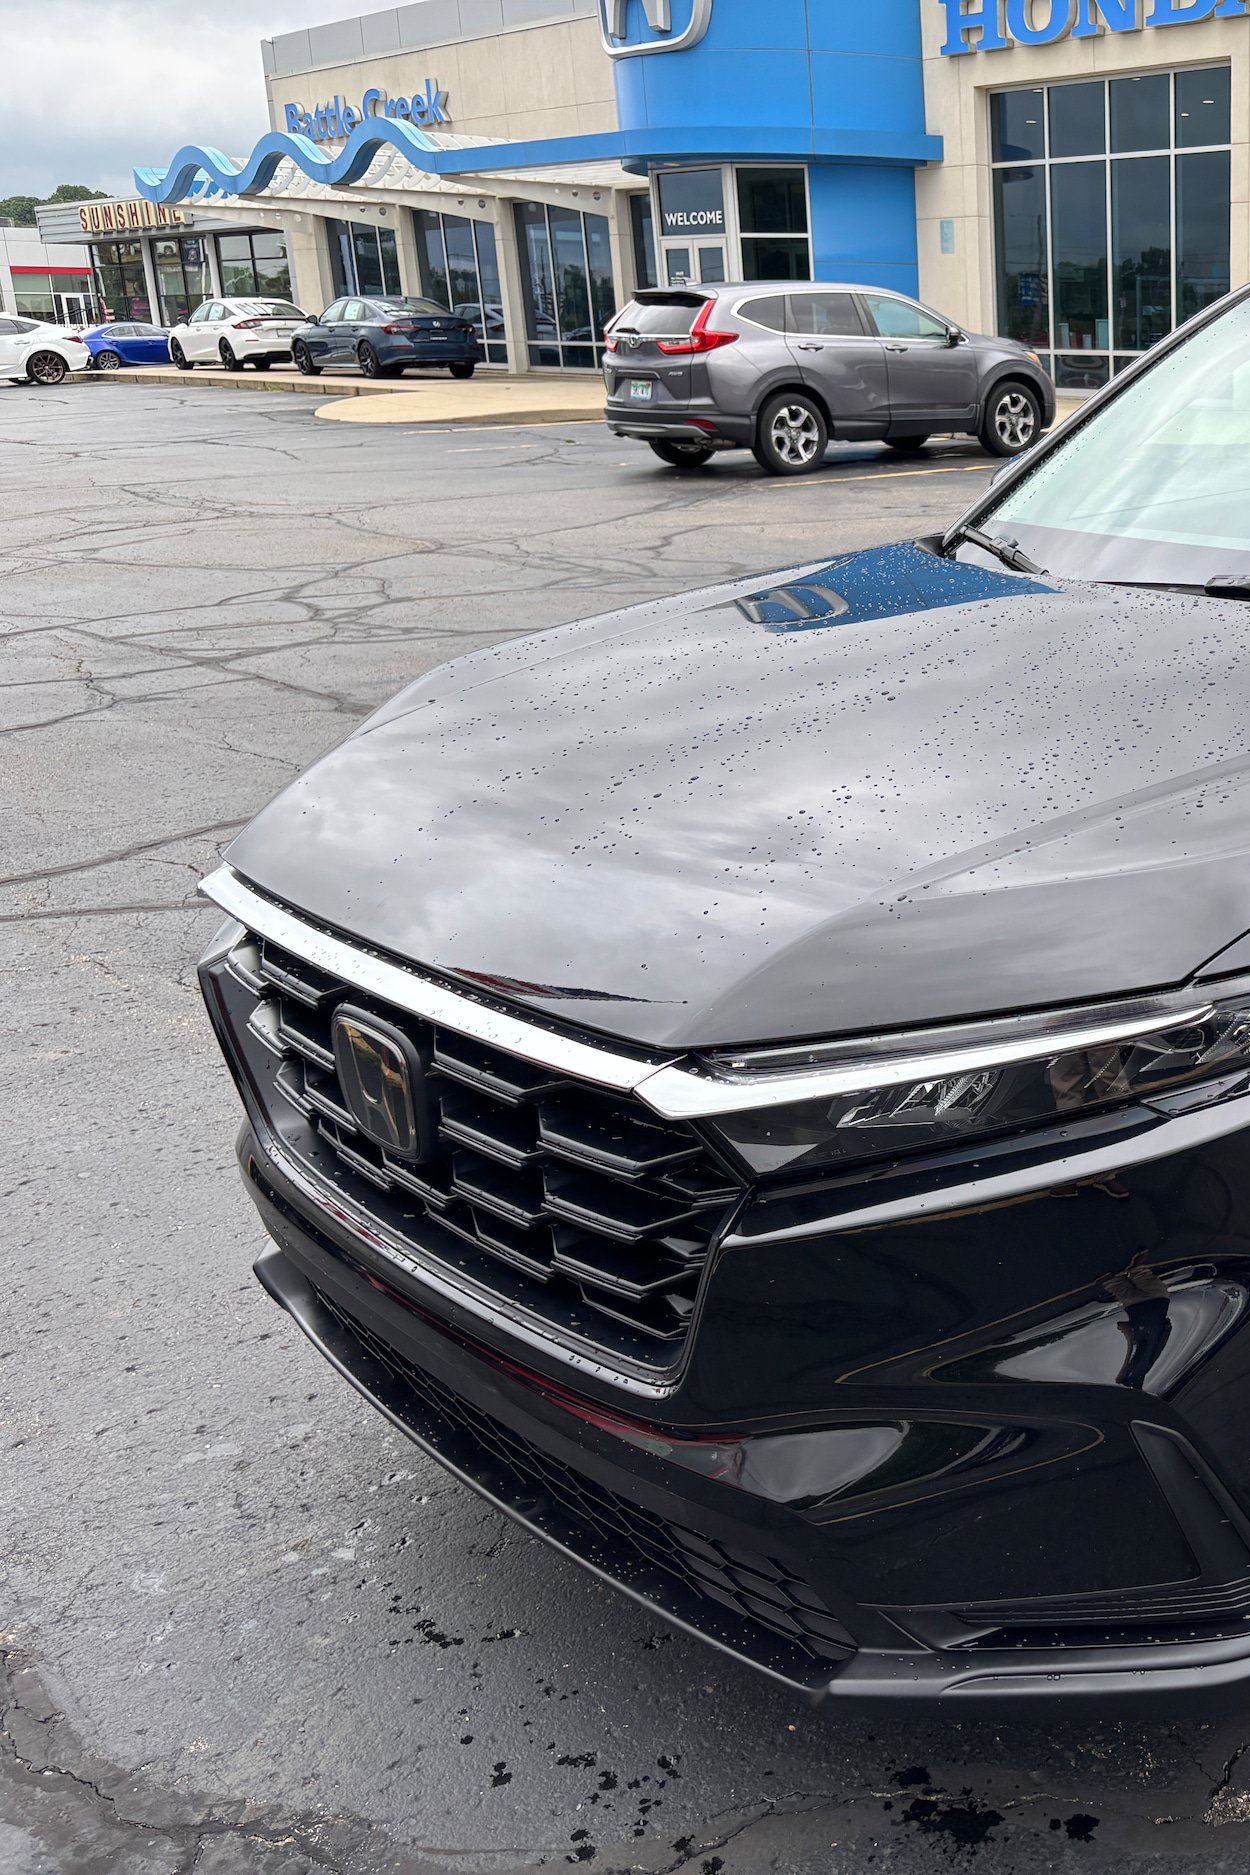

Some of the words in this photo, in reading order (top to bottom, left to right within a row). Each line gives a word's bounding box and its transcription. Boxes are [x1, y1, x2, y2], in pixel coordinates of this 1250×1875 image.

[284, 95, 360, 140] Battle
[363, 78, 450, 127] Creek
[79, 201, 182, 231] SUNSHINE
[664, 210, 723, 227] WELCOME
